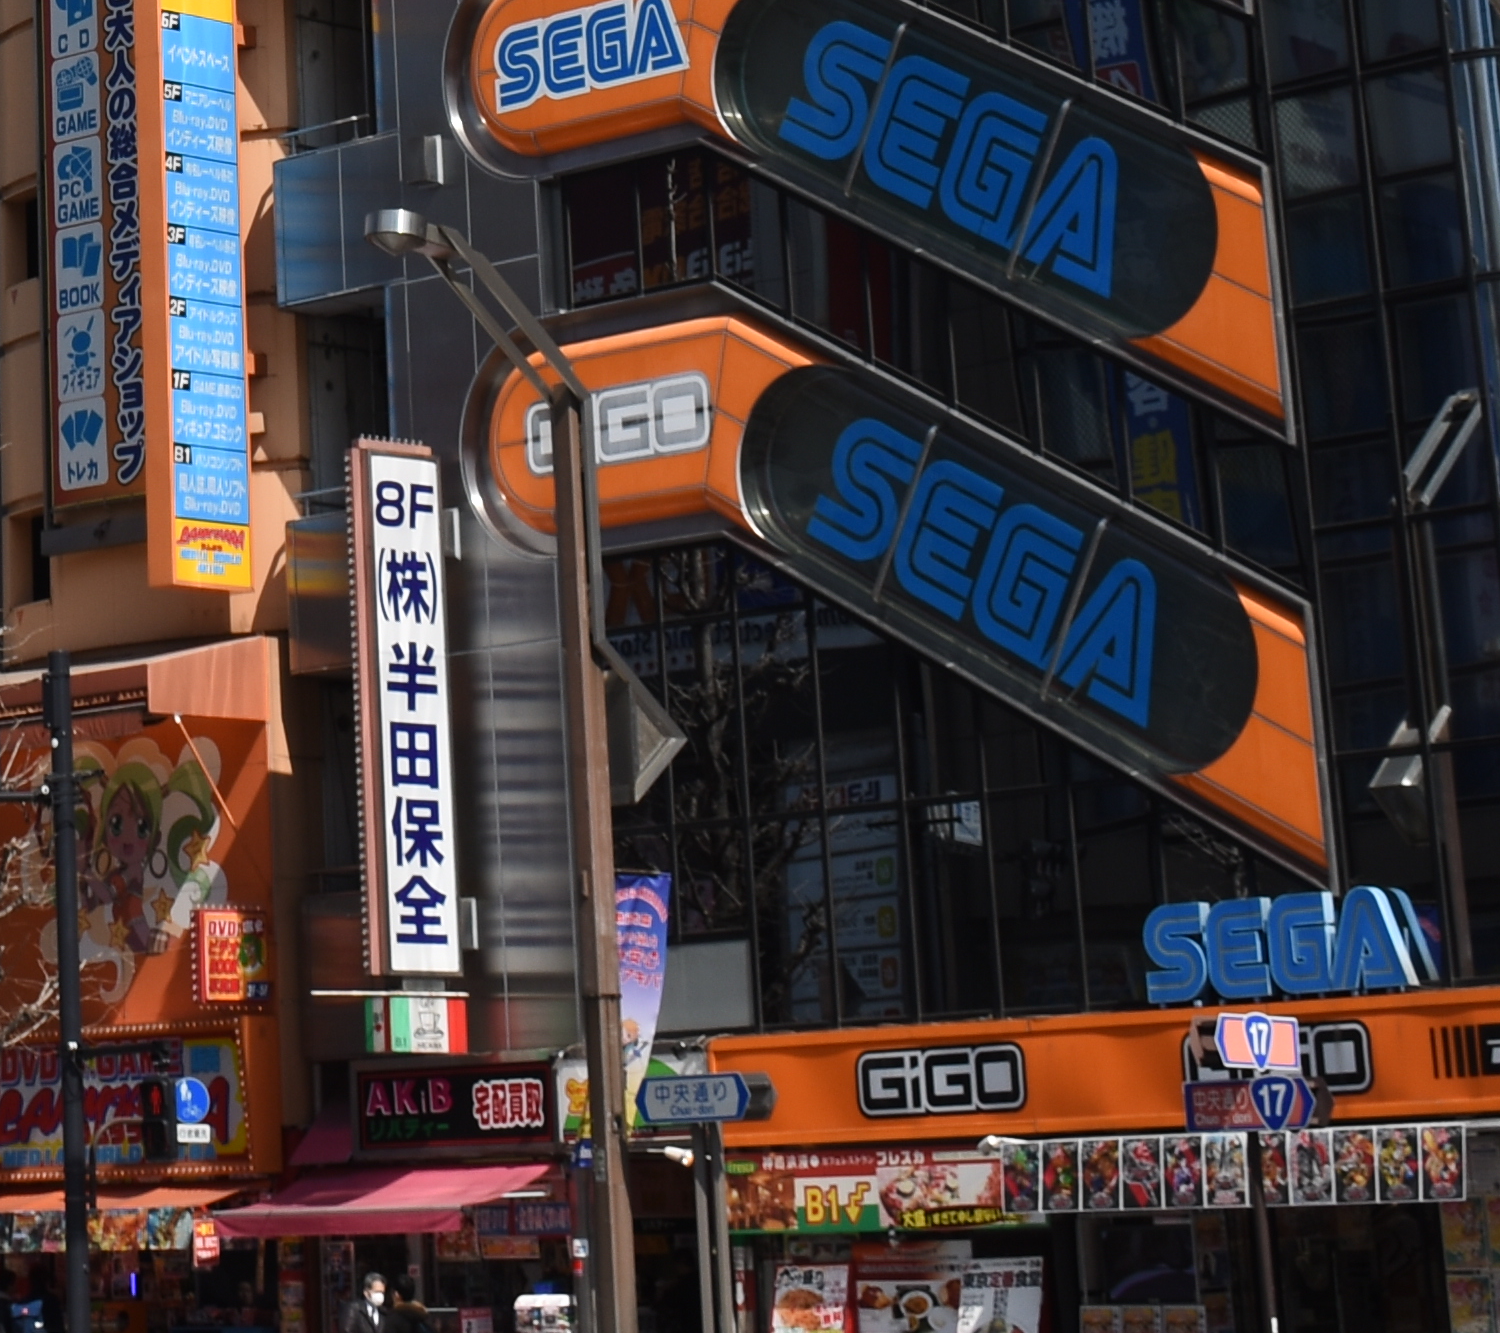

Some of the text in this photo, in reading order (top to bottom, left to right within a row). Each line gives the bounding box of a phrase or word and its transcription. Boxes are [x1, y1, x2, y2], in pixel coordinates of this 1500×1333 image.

[161, 13, 179, 29] 6F
[163, 84, 181, 100] 5F
[56, 111, 98, 135] GAME
[165, 156, 182, 171] 4F
[776, 17, 1120, 299] SEGA
[58, 181, 82, 202] PC
[58, 198, 100, 223] GAME
[167, 227, 184, 242] 3F
[58, 283, 102, 309] BOOK
[170, 300, 186, 315] 2F
[61, 368, 102, 395] フィギュア
[173, 374, 189, 389] 1F
[174, 446, 190, 463] B1
[66, 458, 101, 480] トレカ
[808, 416, 1160, 729] SEGA
[208, 920, 238, 937] DVD
[1141, 884, 1420, 1006] SEGA
[1248, 1022, 1268, 1056] 17
[1, 1050, 60, 1086] DVD
[654, 1080, 728, 1104] 中央通り
[1258, 1084, 1287, 1117] 17
[472, 1079, 545, 1130] 宅配買取
[668, 1104, 716, 1117] Chuo-dori
[803, 1184, 838, 1224] B1
